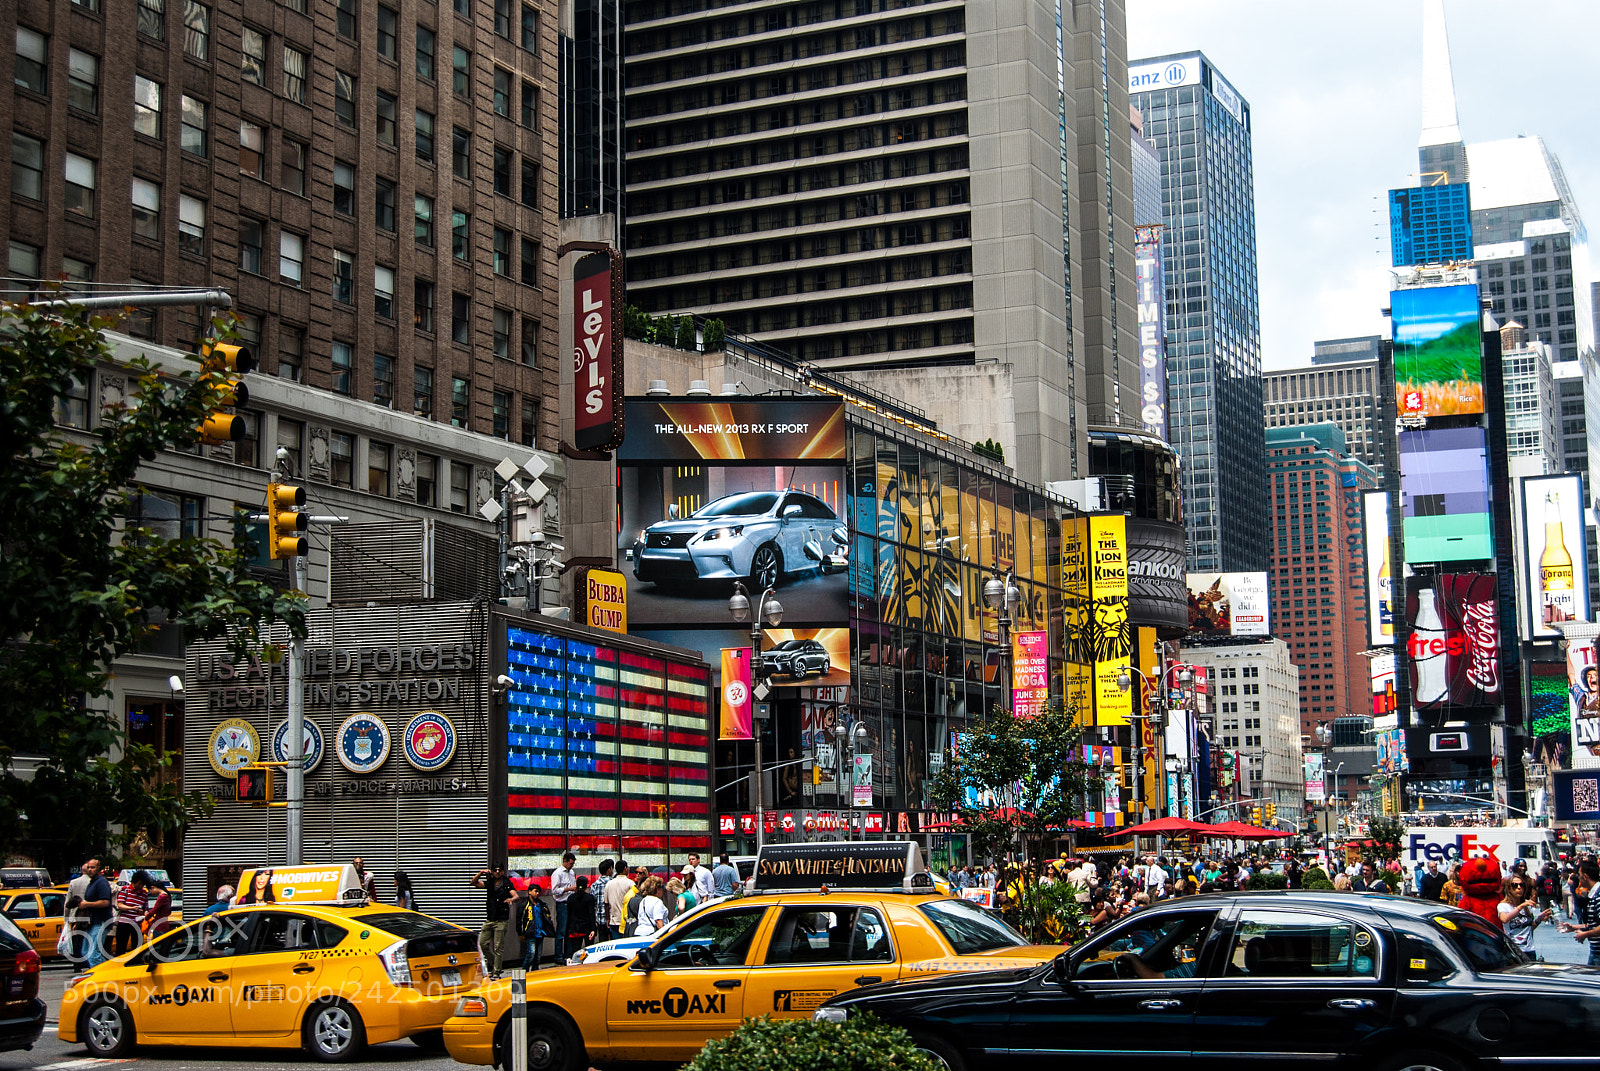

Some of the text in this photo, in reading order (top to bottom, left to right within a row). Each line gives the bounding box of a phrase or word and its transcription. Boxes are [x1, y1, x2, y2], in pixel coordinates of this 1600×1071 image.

[582, 289, 605, 414] Levi's
[1136, 258, 1164, 440] TIMES SQ
[1459, 395, 1473, 403] Rice
[655, 423, 809, 434] THE ALL-NEW 2013 RX F SPORT
[1098, 540, 1117, 548] THE
[1343, 490, 1358, 589] NOVOTEL
[1095, 551, 1122, 564] LION
[1095, 566, 1125, 581] KING
[1130, 576, 1160, 587] driving
[588, 578, 625, 604] BUBBA
[592, 605, 622, 629] GUMP
[245, 649, 352, 680] ARED
[356, 643, 475, 676] FORCES
[1015, 674, 1046, 686] YOGA
[207, 677, 460, 709] RECRUING STATION
[1015, 691, 1033, 699] JUNE
[208, 784, 236, 797] ARM
[340, 780, 387, 793] FORCE
[400, 778, 460, 792] MARINES
[1409, 834, 1500, 862] FedEx
[795, 858, 834, 875] WHITE
[841, 857, 906, 877] HUNTSMAN
[270, 871, 340, 885] #MOBWIVES
[298, 951, 320, 960] 7V27
[596, 944, 615, 953] POLICE
[908, 962, 940, 972] 1K13
[149, 984, 215, 1007] NYC TAXI
[626, 987, 726, 1018] NYC TAXI
